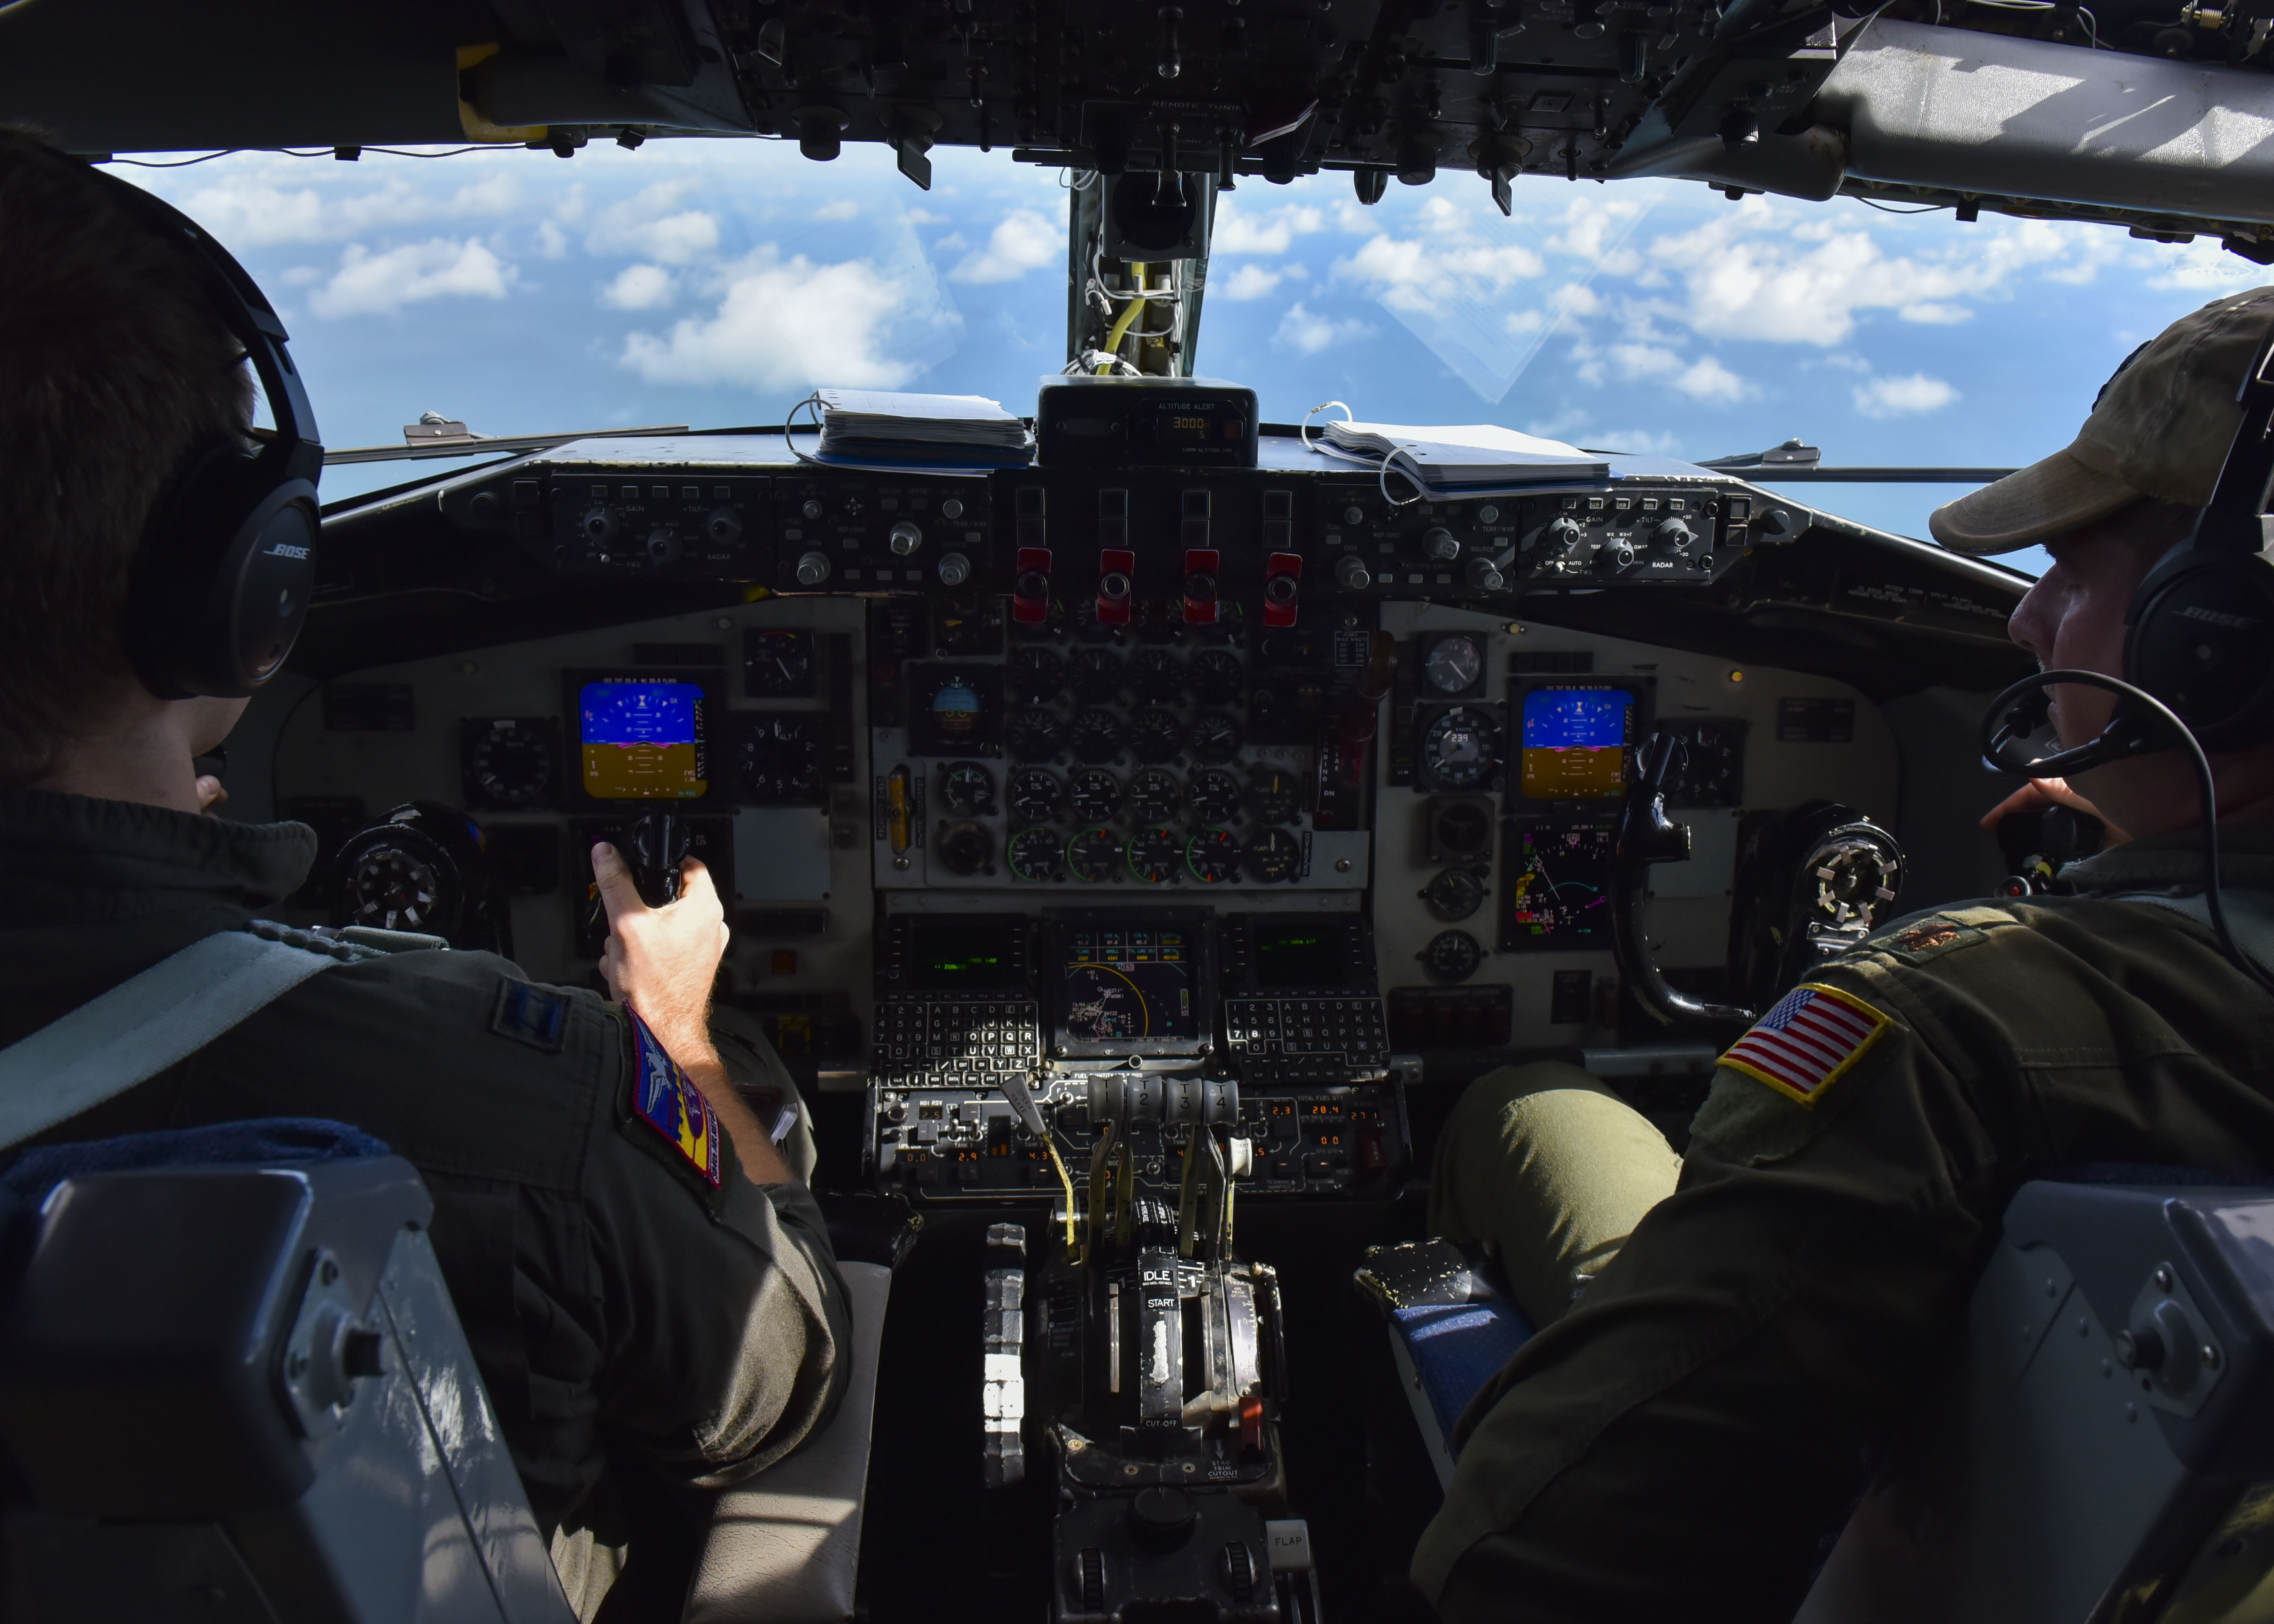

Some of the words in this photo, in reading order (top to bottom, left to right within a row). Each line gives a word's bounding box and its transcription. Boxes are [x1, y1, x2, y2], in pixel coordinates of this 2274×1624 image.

[1173, 417, 1204, 429] 3000
[267, 543, 311, 560] BOSE
[2177, 606, 2259, 629] BOSE
[1451, 734, 1469, 742] 239
[747, 743, 754, 751] 8
[1102, 1079, 1111, 1088] T
[1139, 1080, 1149, 1090] T
[1180, 1084, 1189, 1093] T
[1216, 1084, 1226, 1094] T
[1017, 1089, 1033, 1110] SPEED
[1105, 1091, 1108, 1103] 1
[1139, 1093, 1149, 1105] 2
[1011, 1093, 1027, 1114] BRAKE
[1180, 1097, 1190, 1109] 3
[1216, 1097, 1227, 1109] 4
[1272, 1106, 1291, 1115] 2.3
[1312, 1106, 1339, 1115] 28.4
[908, 1153, 926, 1162] 0.0
[958, 1152, 978, 1161] 2.9
[1029, 1152, 1048, 1161] 4.3
[1144, 1271, 1171, 1281] IDLE
[1188, 1275, 1195, 1287] 1
[1148, 1298, 1174, 1308] START
[1275, 1537, 1302, 1546] FLAP
